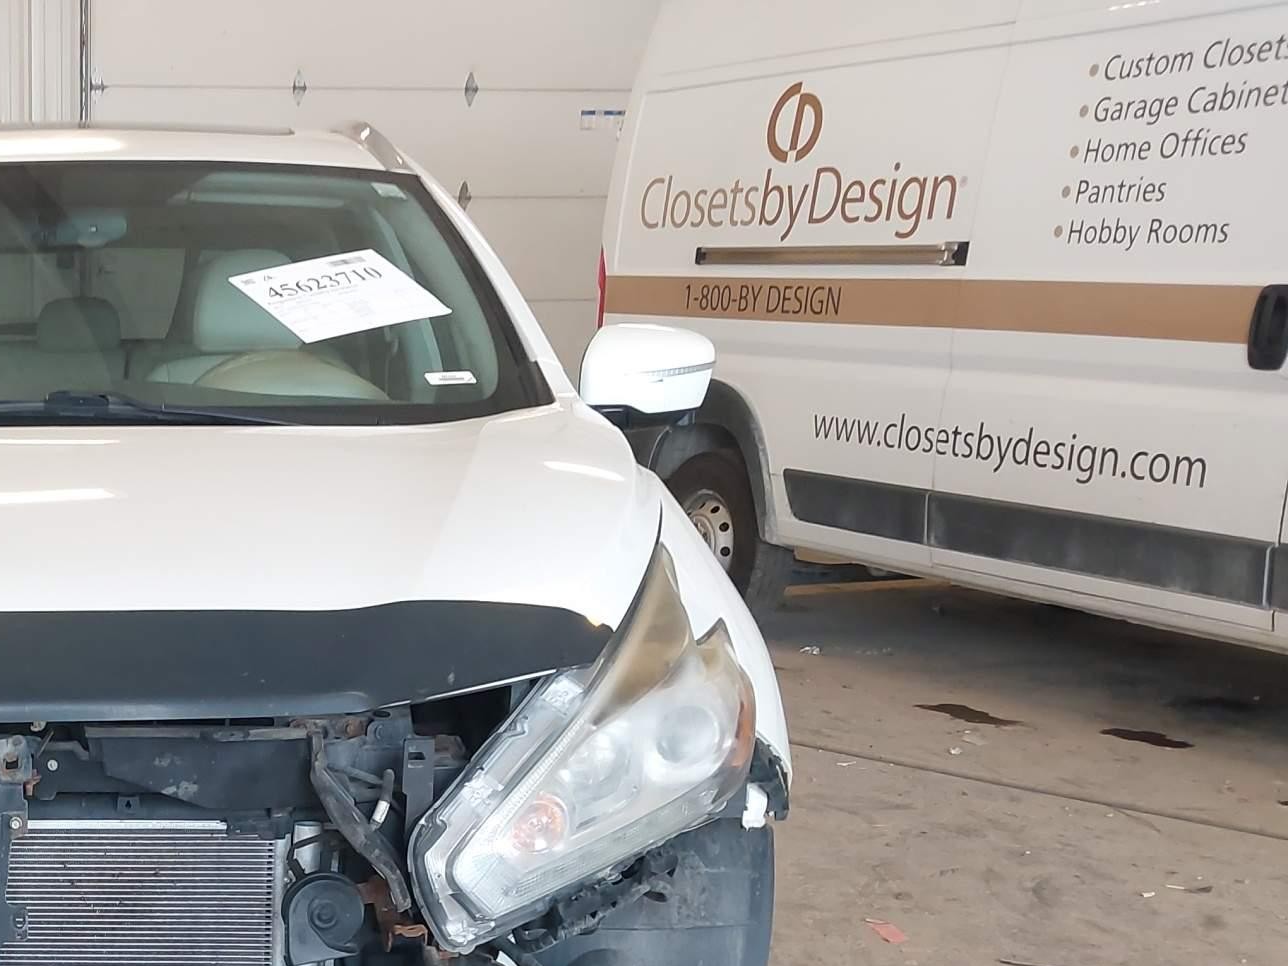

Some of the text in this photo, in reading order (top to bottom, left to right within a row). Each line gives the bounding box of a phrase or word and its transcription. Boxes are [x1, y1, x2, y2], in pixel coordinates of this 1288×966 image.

[1104, 51, 1194, 81] Custom
[1094, 80, 1288, 126] Garage Cabinet
[1083, 128, 1249, 164] Home Offices
[1075, 176, 1167, 205] Pantries
[1067, 217, 1230, 252] Hobby Rooms
[268, 267, 383, 298] 45623710
[684, 284, 842, 316] 1-800-BY DESIGN
[813, 413, 1208, 489] www.closetsbydesign.com
